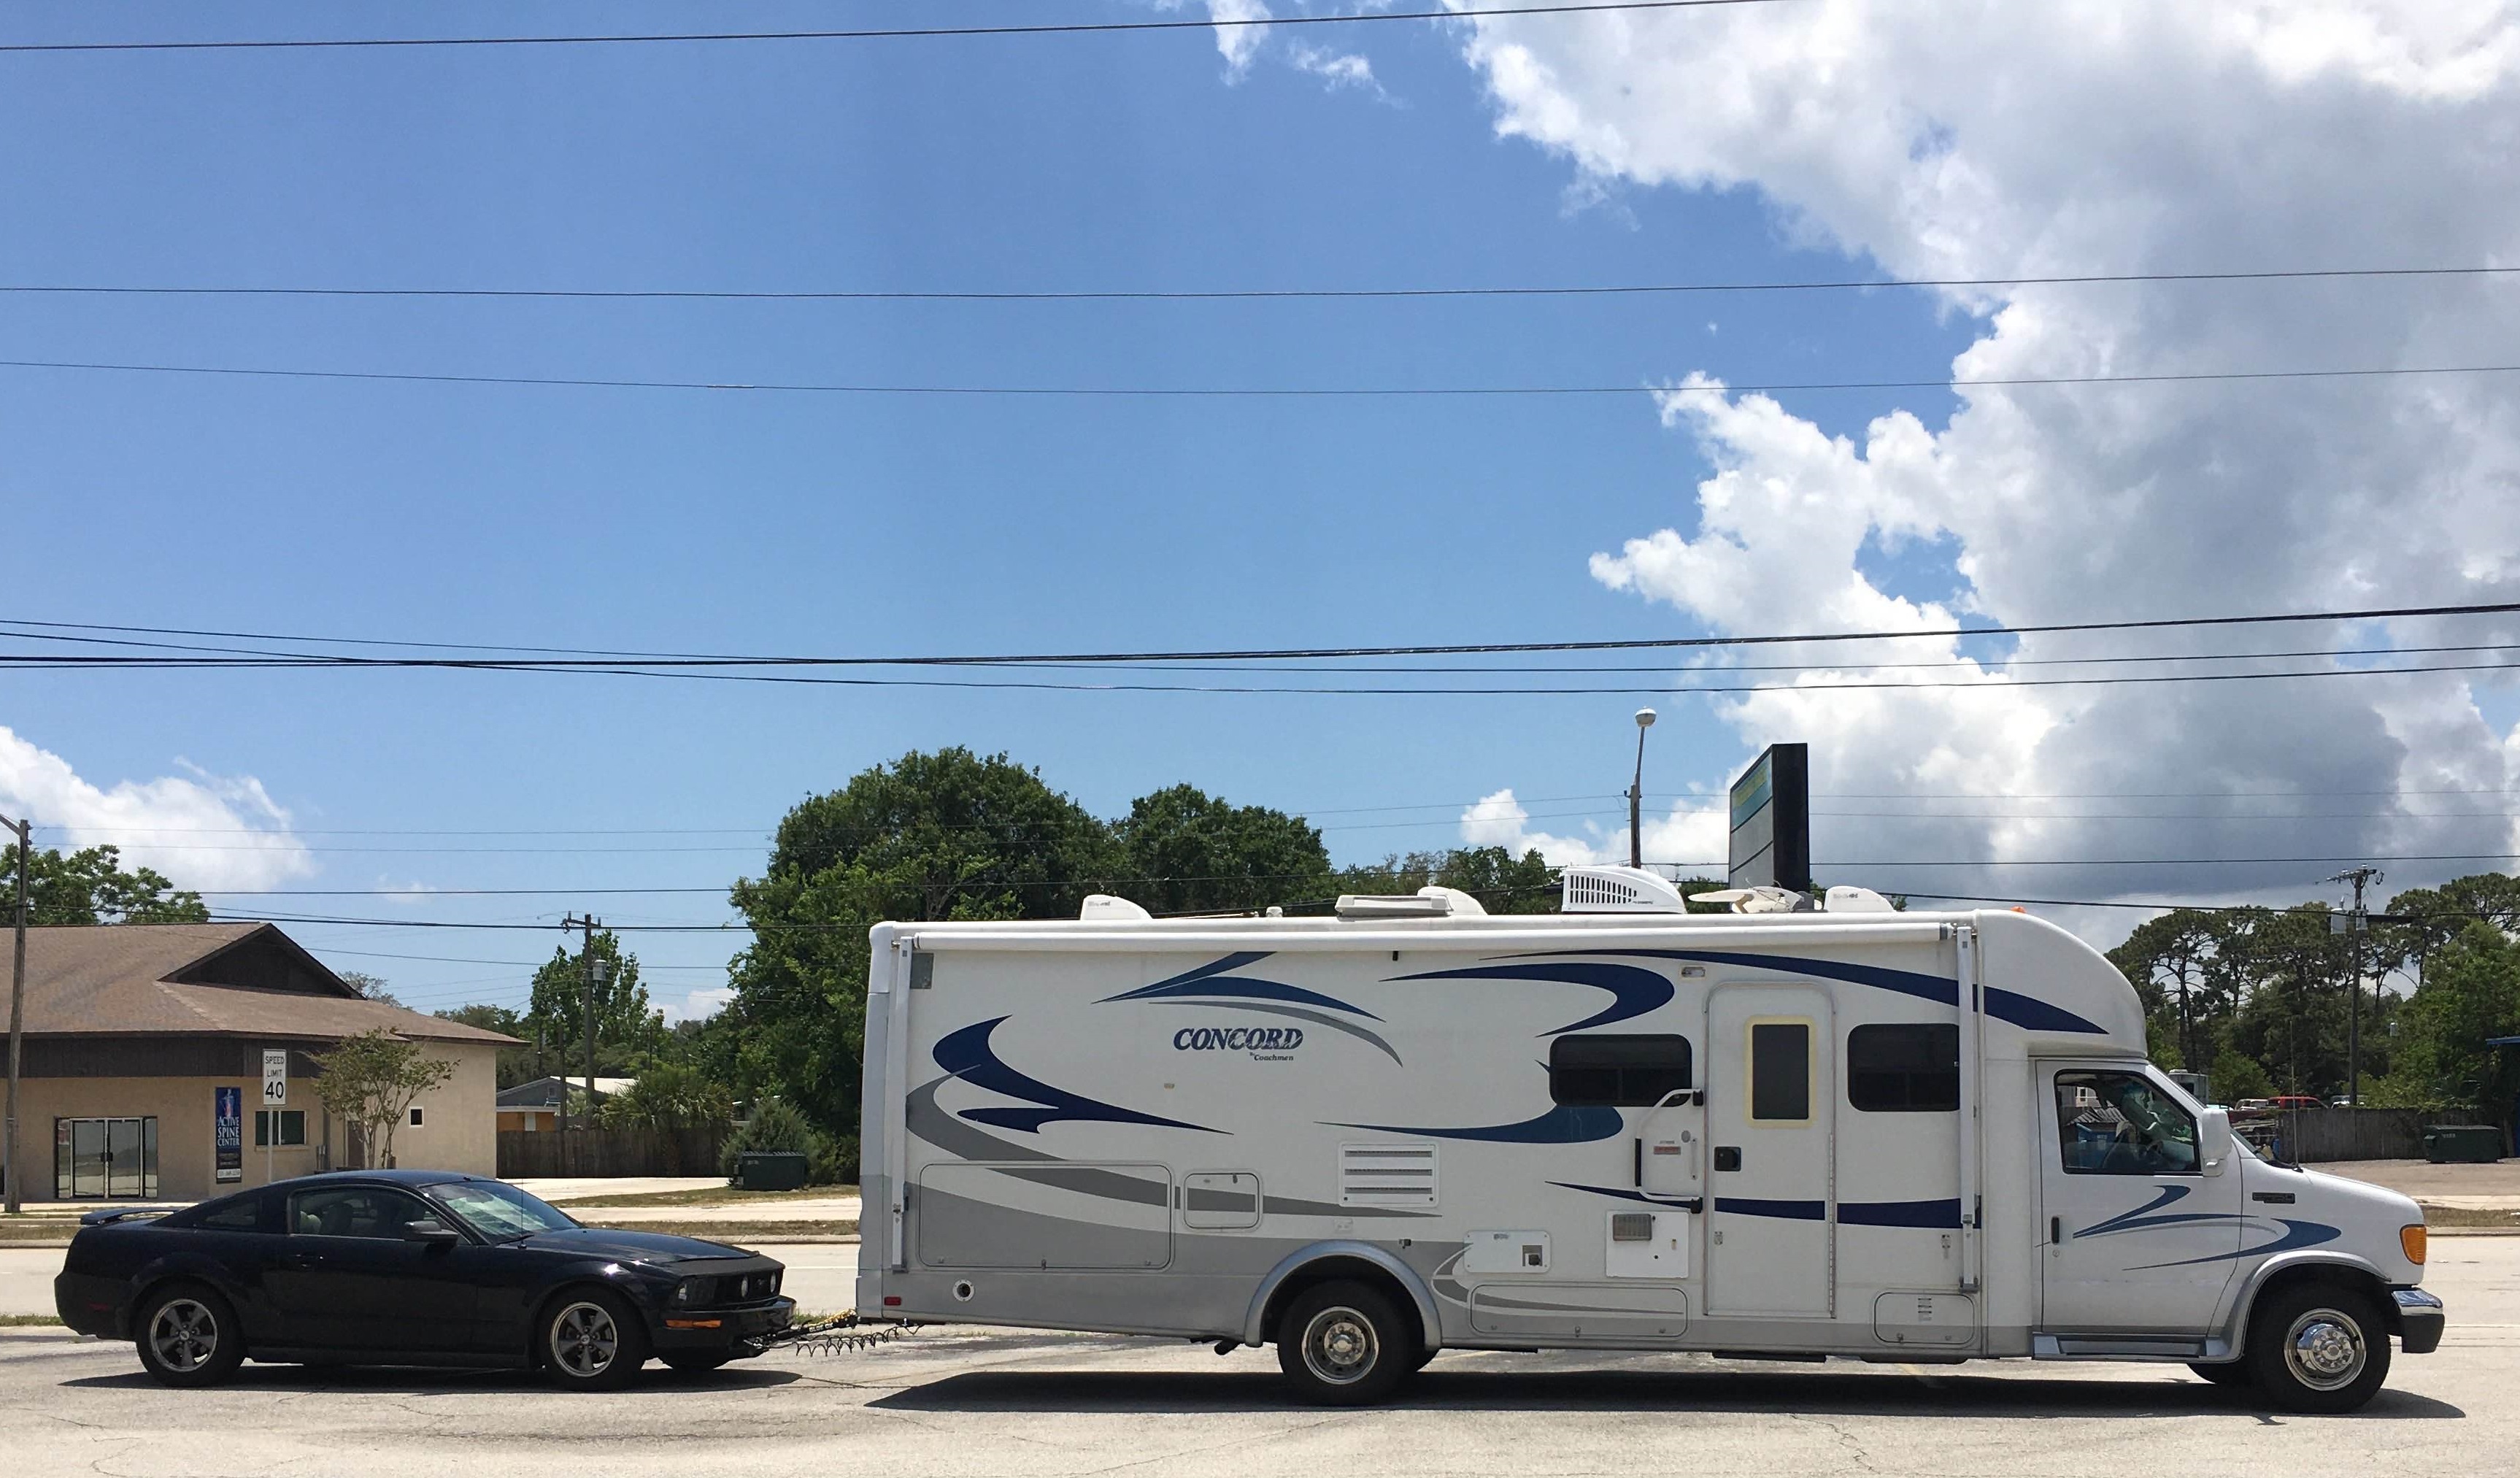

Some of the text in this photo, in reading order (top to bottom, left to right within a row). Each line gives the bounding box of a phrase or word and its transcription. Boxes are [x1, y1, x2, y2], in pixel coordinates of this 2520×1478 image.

[1174, 1028, 1303, 1050] CONCORD
[265, 1056, 285, 1064] SPEED
[267, 1069, 282, 1077] LIMIT
[265, 1081, 284, 1098] 40
[218, 1116, 239, 1126] ACTIVE
[218, 1127, 239, 1138] SPINE
[217, 1138, 240, 1147] CENTER
